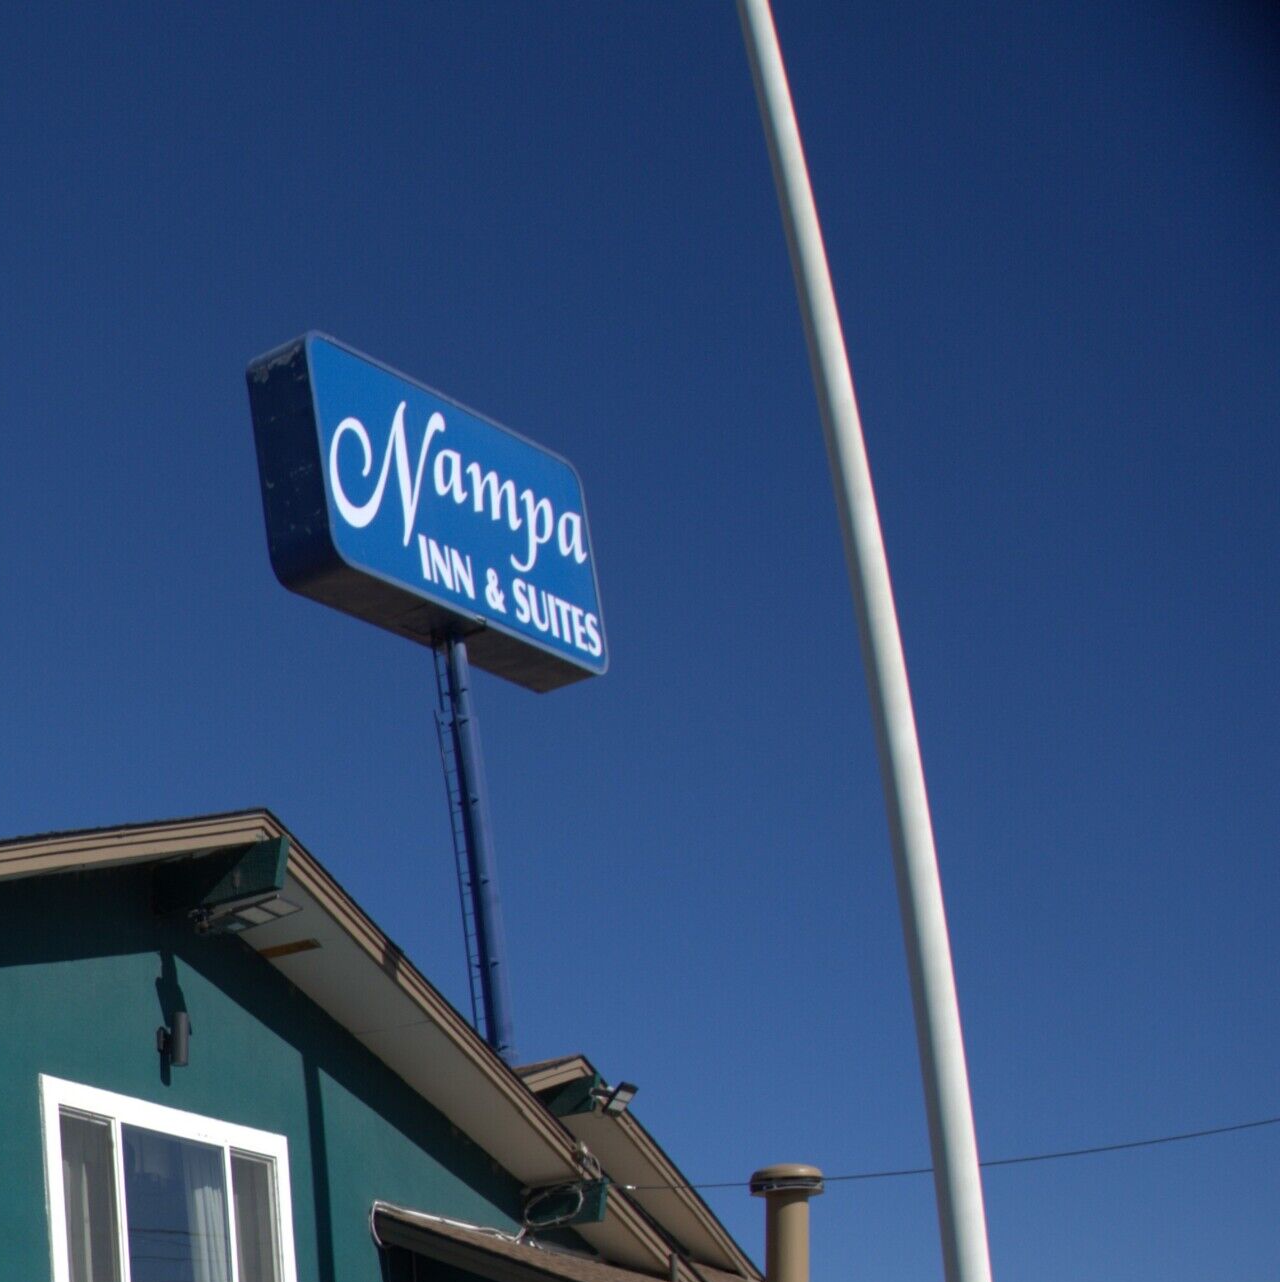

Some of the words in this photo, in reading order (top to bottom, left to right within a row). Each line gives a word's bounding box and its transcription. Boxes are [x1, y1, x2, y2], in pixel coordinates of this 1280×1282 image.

[329, 401, 587, 573] Nampa
[418, 533, 475, 600] INN
[485, 567, 507, 614] &
[512, 577, 603, 657] SUITES
